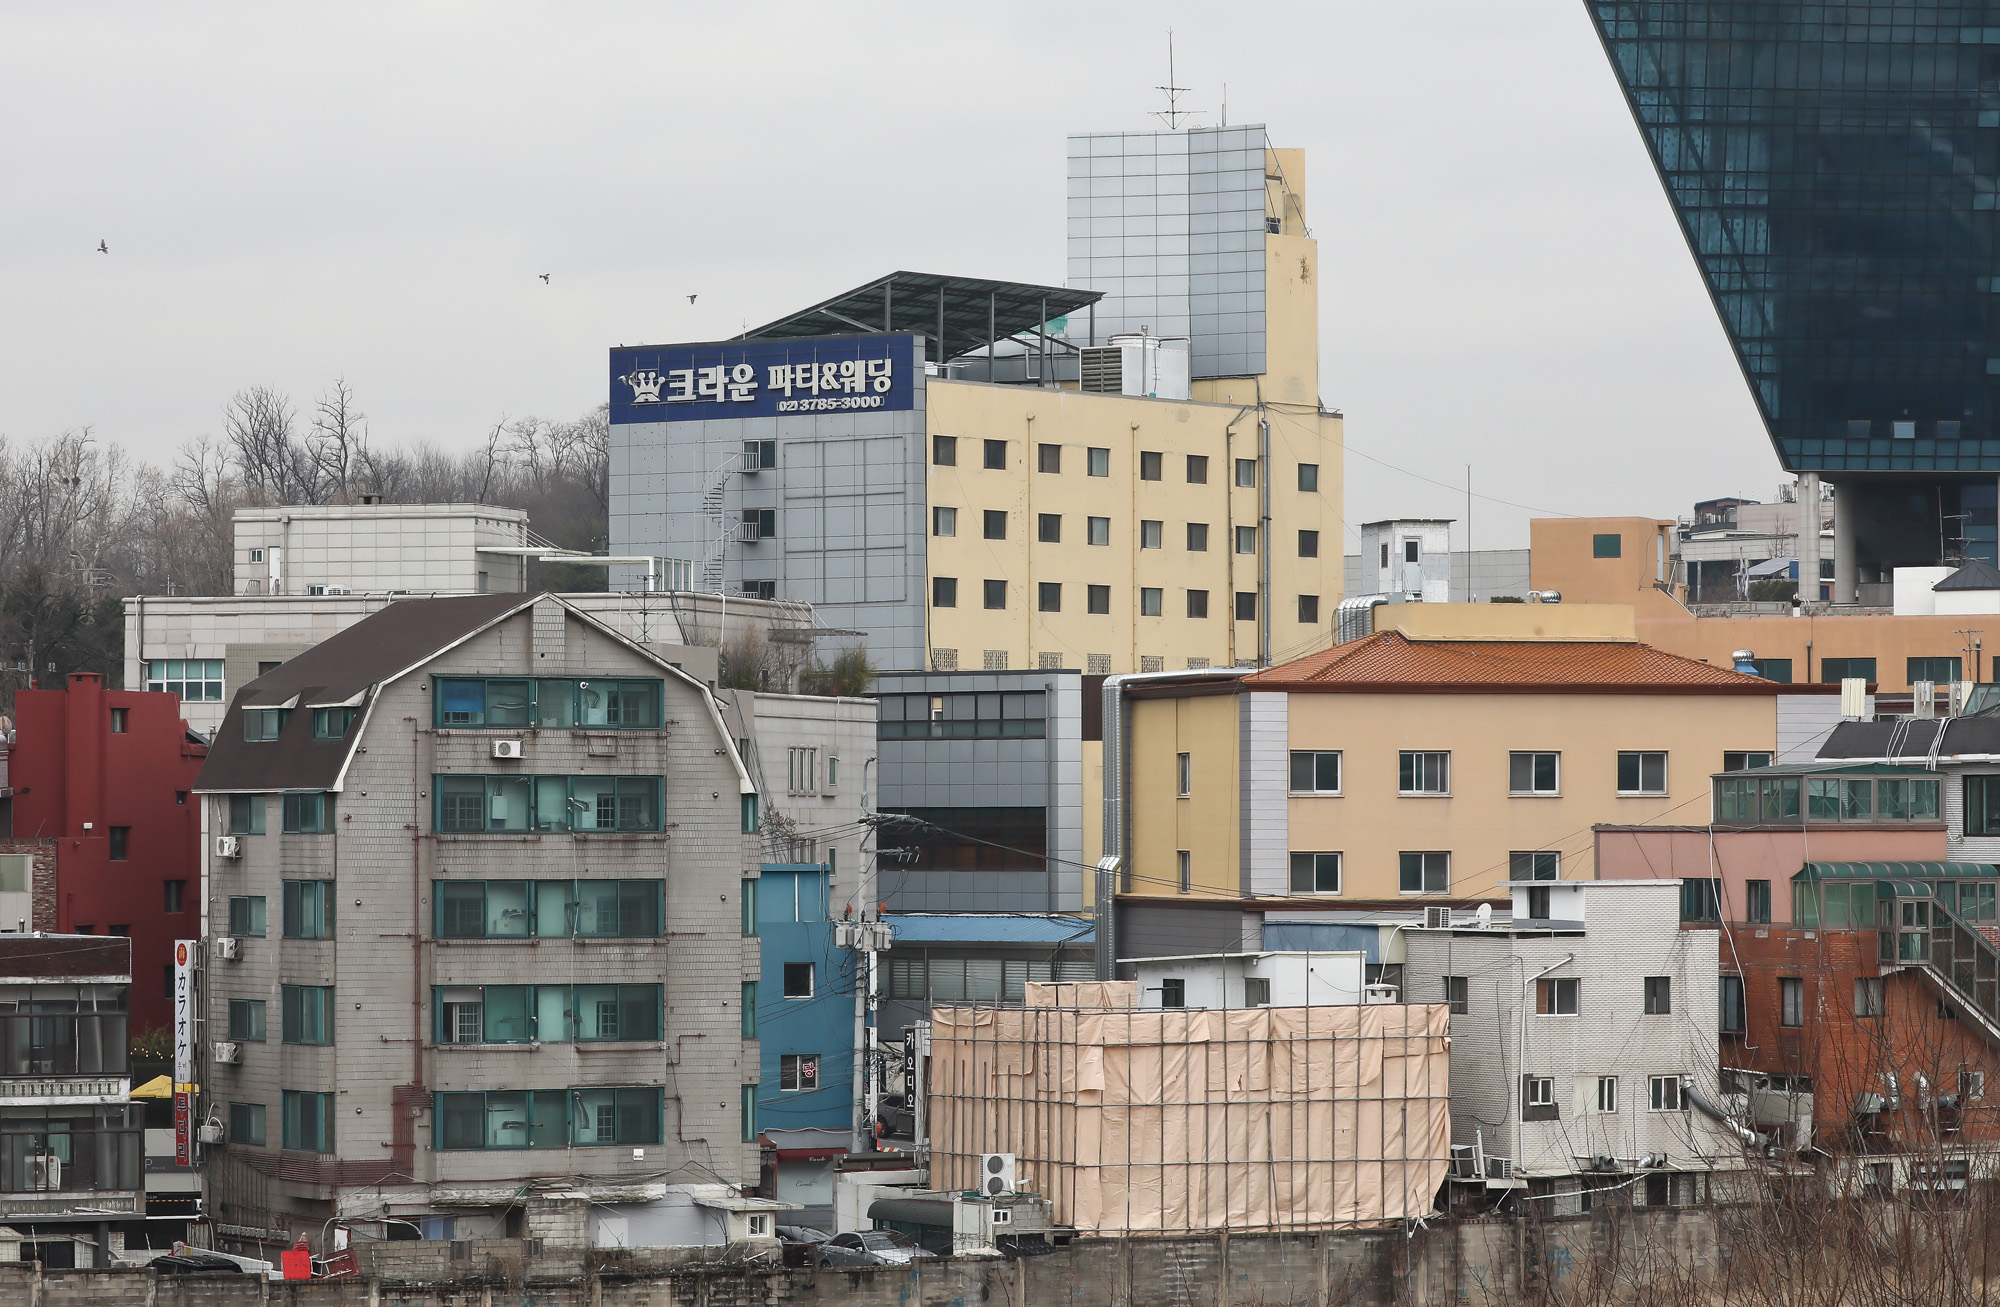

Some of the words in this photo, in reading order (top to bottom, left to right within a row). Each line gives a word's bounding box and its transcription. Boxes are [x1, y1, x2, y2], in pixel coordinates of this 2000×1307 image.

[667, 363, 759, 403] 크라운
[767, 358, 892, 397] 파티&웨딩
[177, 971, 187, 1058] カラオケ
[906, 1032, 915, 1108] 카오디오
[177, 1097, 187, 1161] 투다리
